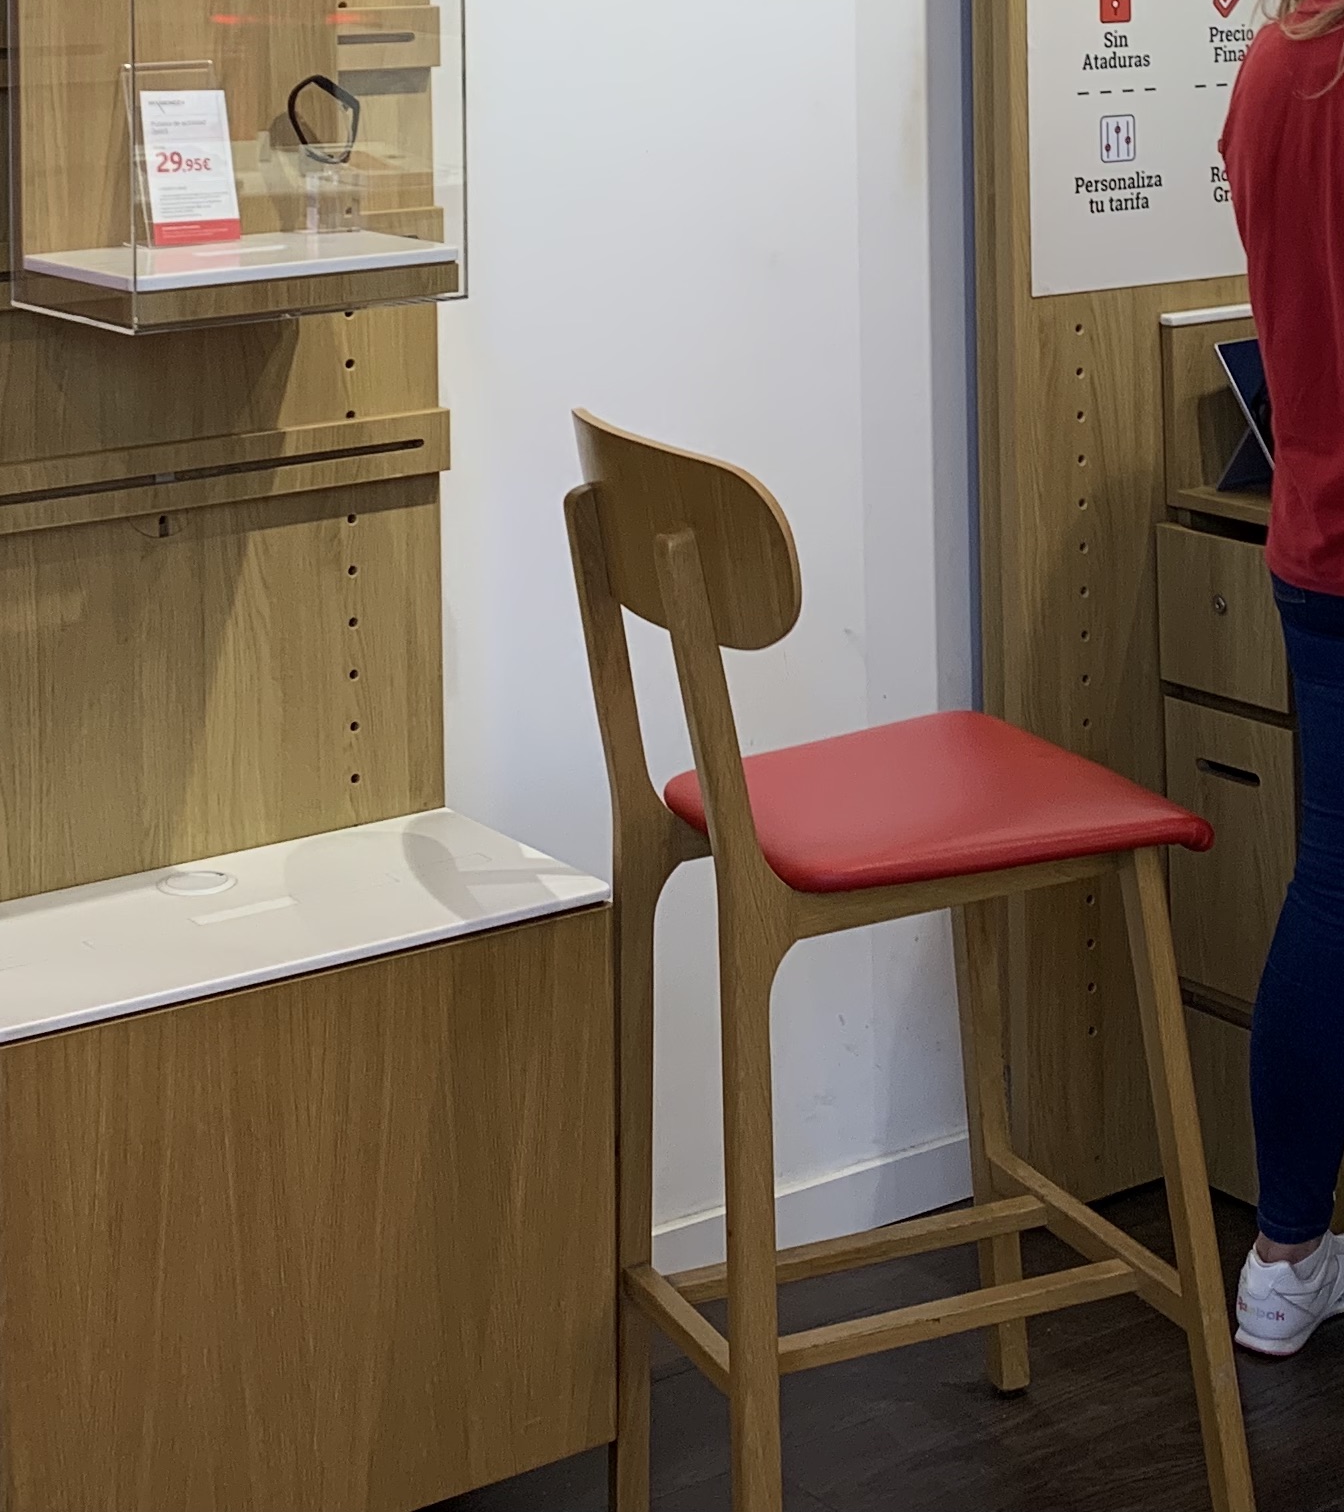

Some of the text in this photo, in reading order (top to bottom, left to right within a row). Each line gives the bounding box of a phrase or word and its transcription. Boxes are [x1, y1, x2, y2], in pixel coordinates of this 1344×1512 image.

[1103, 30, 1128, 48] Sin
[1209, 25, 1254, 43] Precio
[1082, 52, 1151, 71] Ataduras
[1074, 171, 1163, 194] Personaliza
[1089, 193, 1150, 214] tu tarifa
[1238, 1295, 1285, 1322] Rebok
